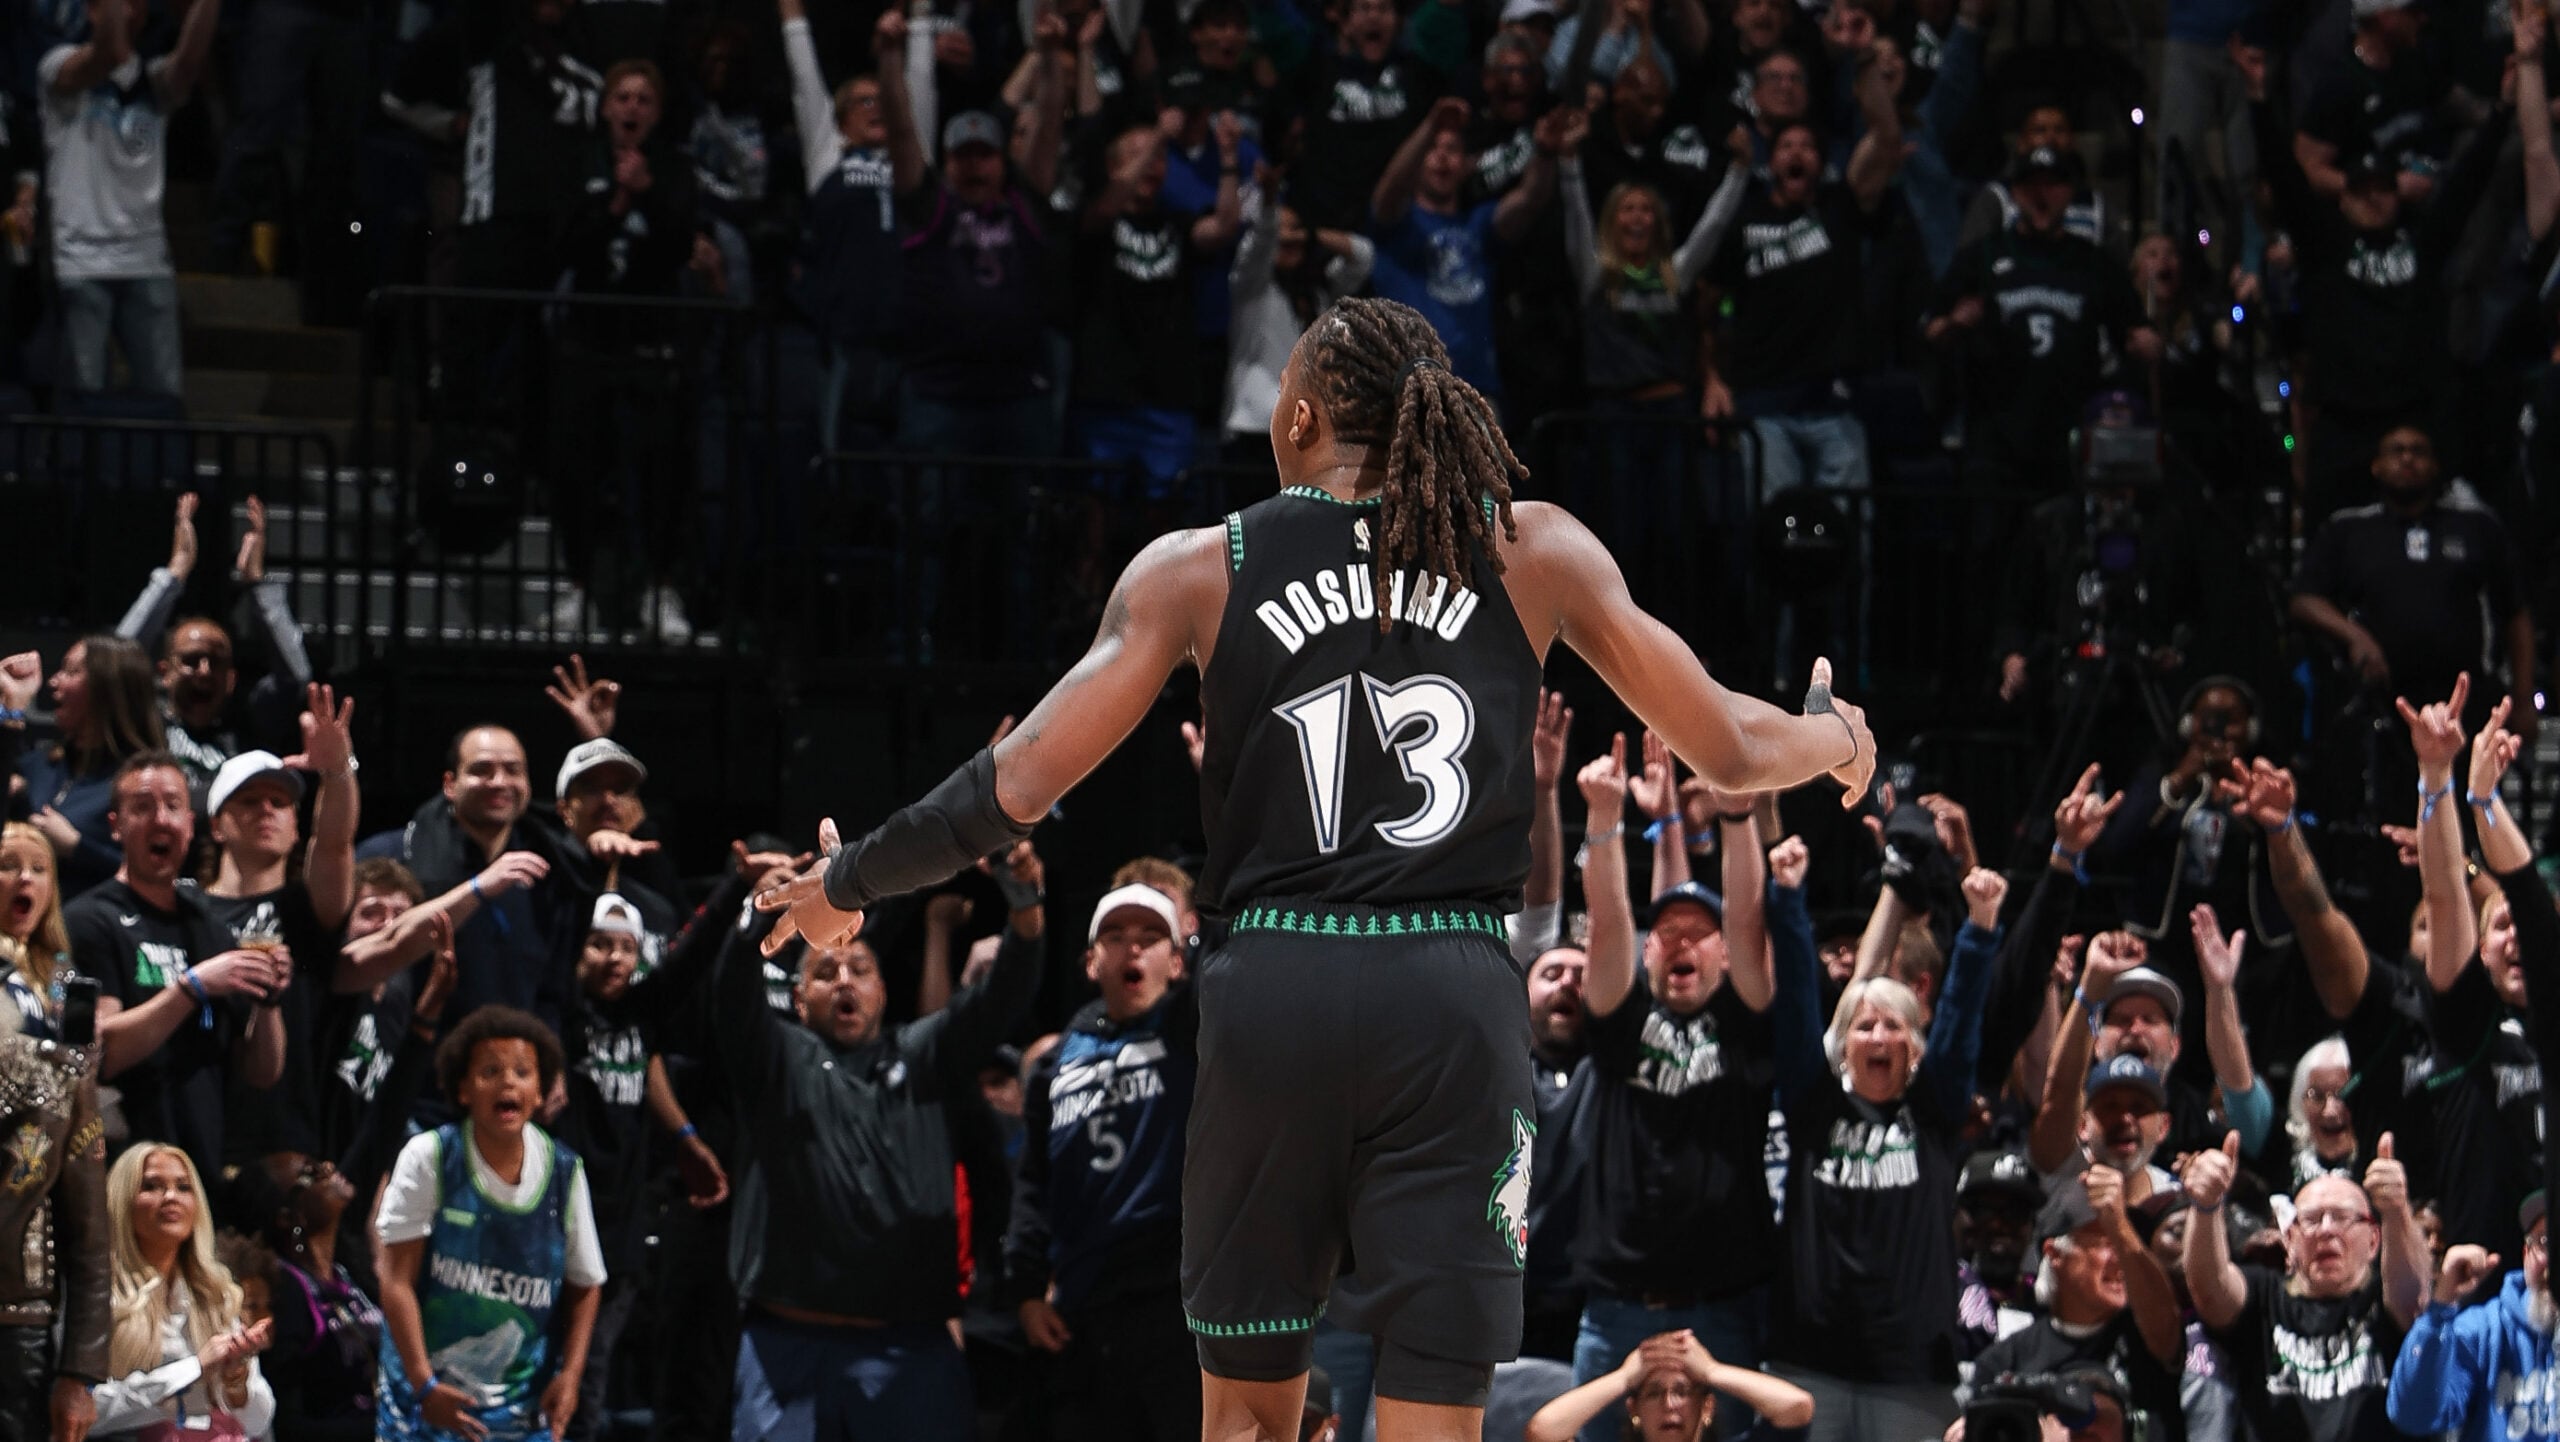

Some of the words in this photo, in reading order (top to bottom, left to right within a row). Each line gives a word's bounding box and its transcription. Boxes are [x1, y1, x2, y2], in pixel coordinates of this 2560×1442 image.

[2027, 314, 2055, 358] 5
[1271, 669, 1476, 855] 13
[1050, 1066, 1166, 1130] MINSOTA
[1087, 1111, 1126, 1173] 5
[429, 1250, 553, 1309] MINNESOTA
